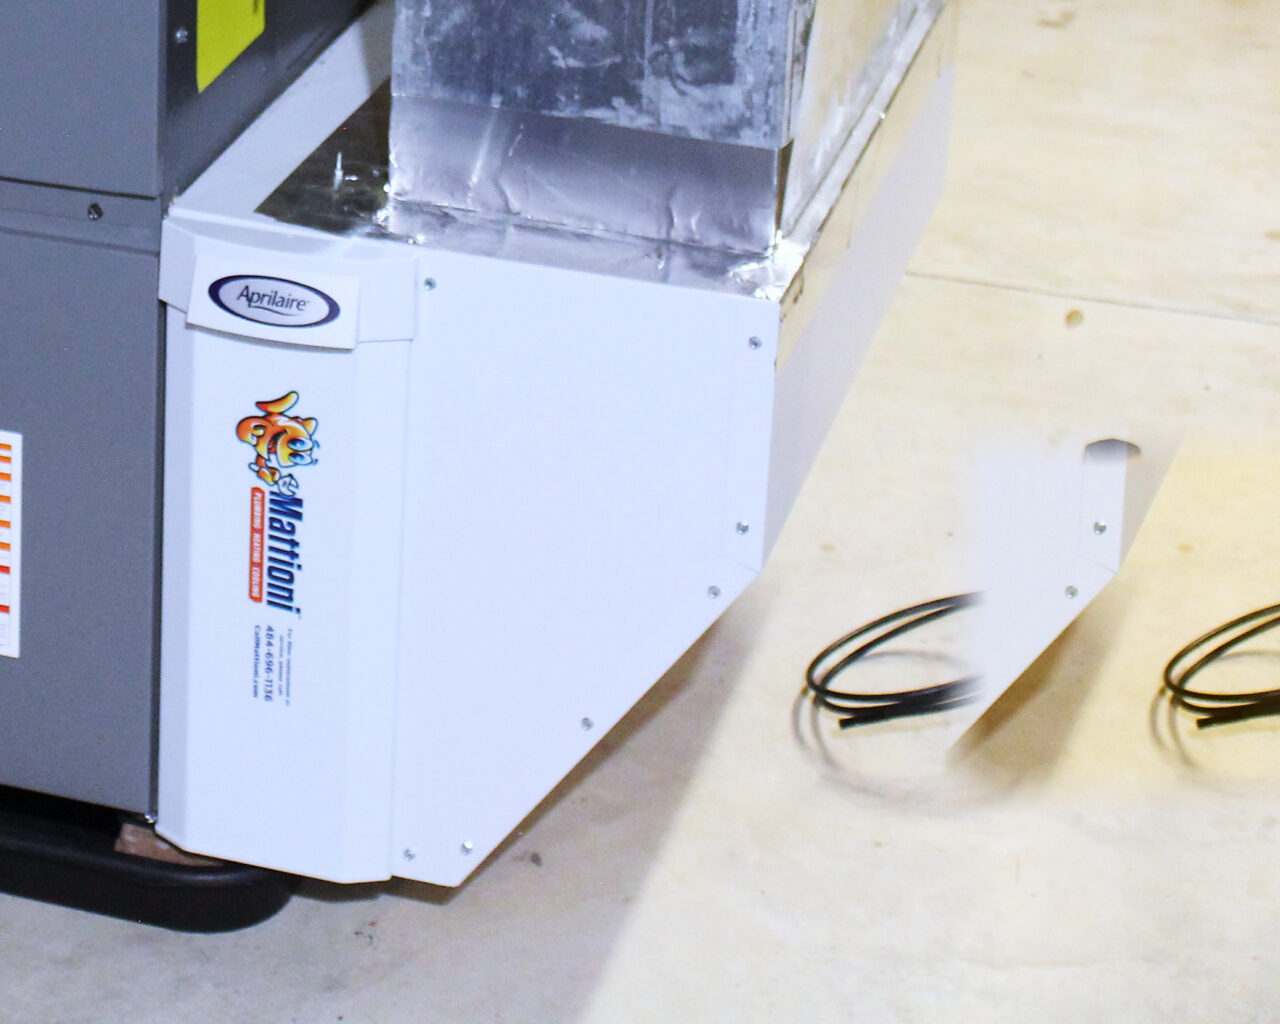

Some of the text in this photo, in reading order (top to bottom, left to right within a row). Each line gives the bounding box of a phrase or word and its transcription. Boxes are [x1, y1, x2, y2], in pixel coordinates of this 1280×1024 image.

[236, 285, 307, 312] Aprilaire
[251, 492, 262, 598] PLUMBING HEATING COOLING
[266, 490, 303, 614] Mattioni
